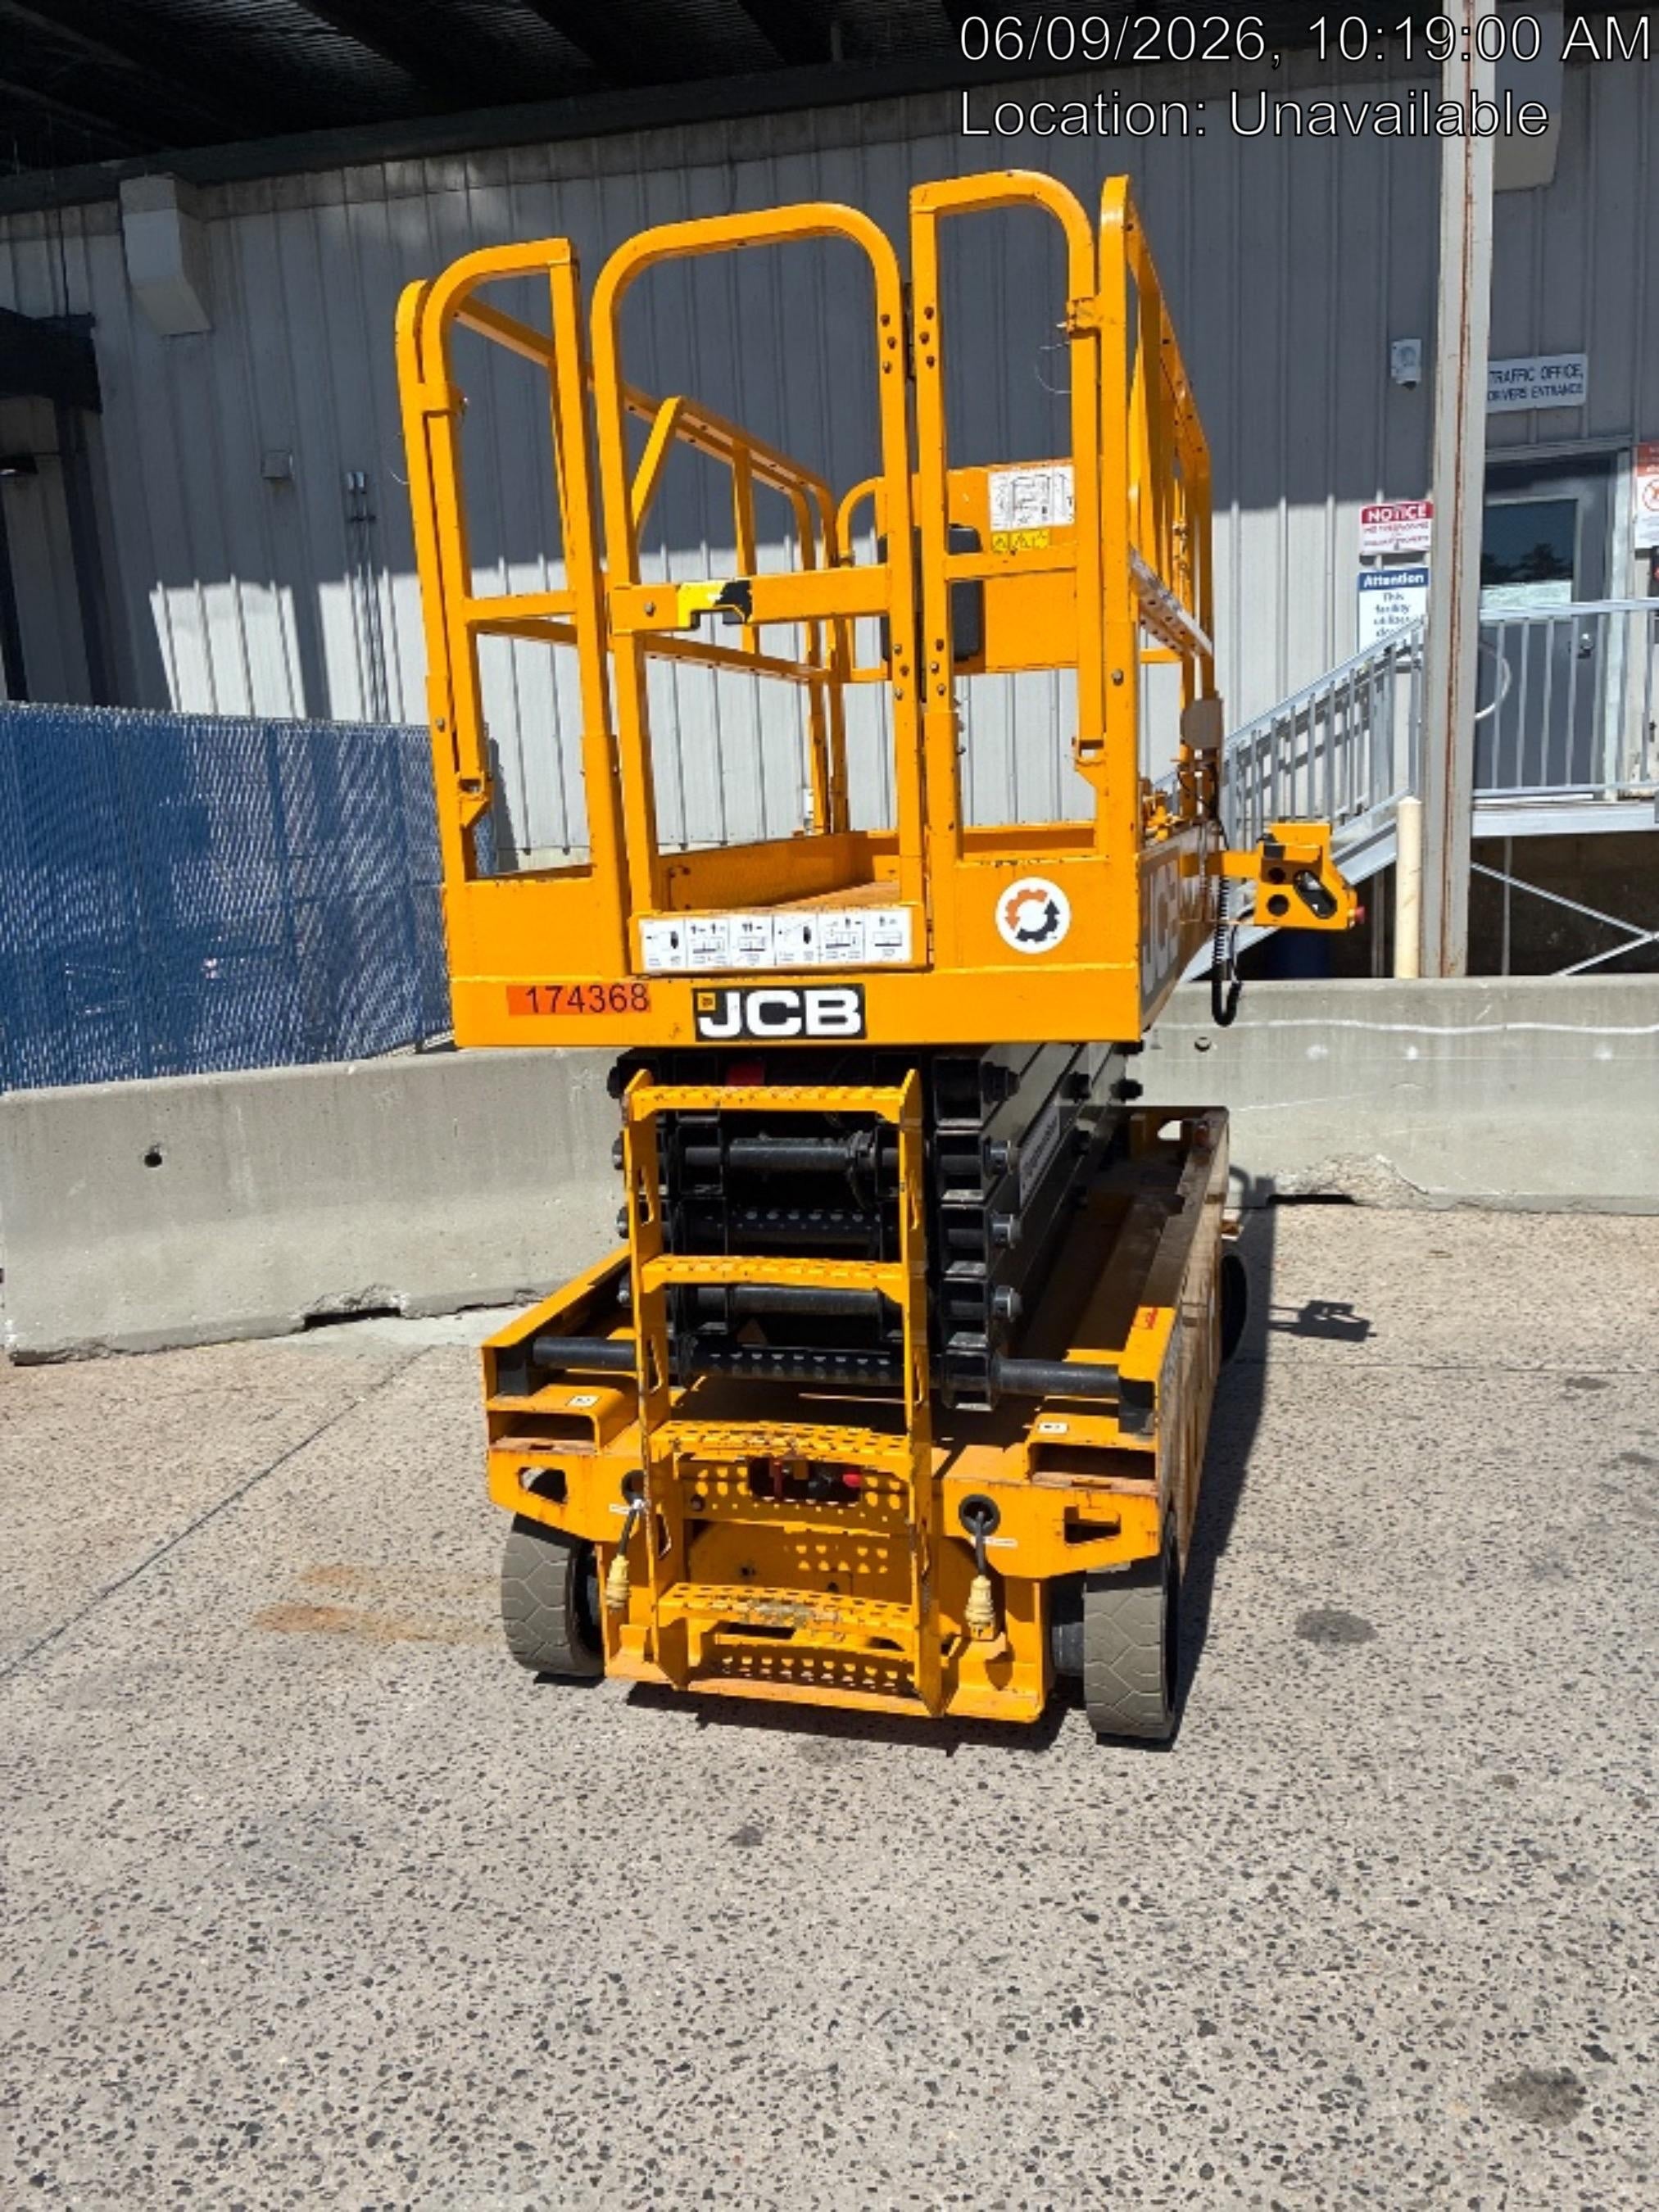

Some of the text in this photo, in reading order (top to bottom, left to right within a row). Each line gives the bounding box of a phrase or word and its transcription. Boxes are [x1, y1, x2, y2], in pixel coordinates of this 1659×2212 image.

[1488, 366, 1534, 384] TRAFFIC
[1531, 383, 1583, 399] ENTRANCE
[1368, 505, 1426, 523] NOTICE
[1363, 572, 1424, 588] Attention
[1383, 592, 1404, 602] This
[525, 982, 650, 1014] 174368
[698, 989, 862, 1038] JCB
